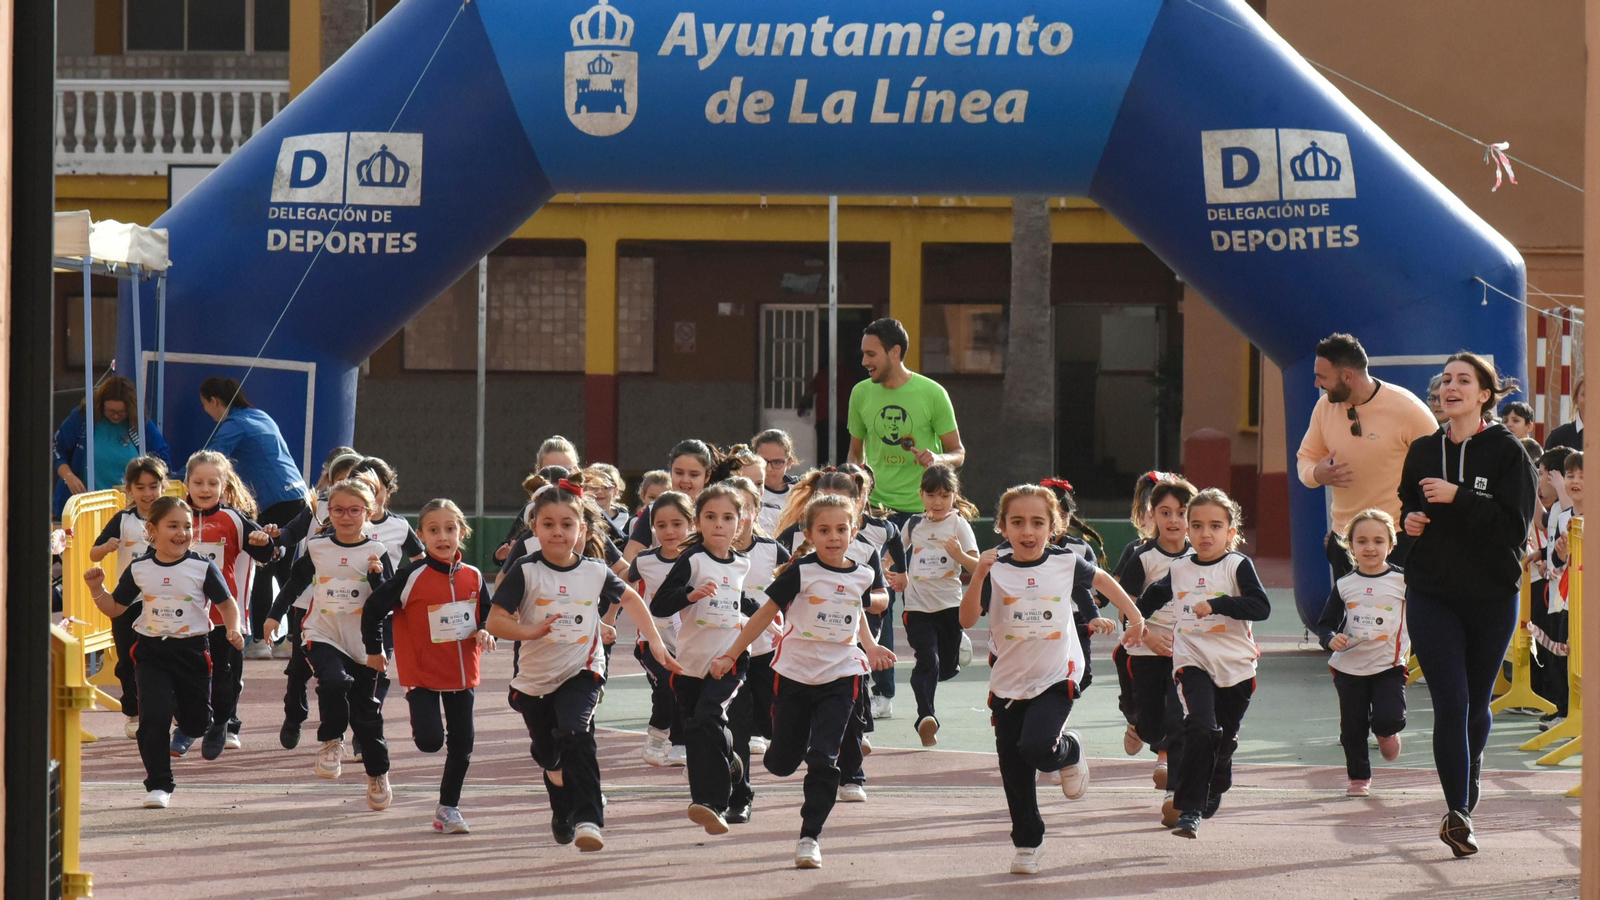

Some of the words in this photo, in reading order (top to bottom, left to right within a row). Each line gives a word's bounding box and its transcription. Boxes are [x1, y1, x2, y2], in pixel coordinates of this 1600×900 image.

[658, 10, 1074, 71] Ayuntamiento
[705, 76, 775, 124] de
[788, 78, 857, 124] La
[870, 76, 1029, 124] Línea
[289, 149, 328, 189] D
[1221, 147, 1261, 189] D
[268, 206, 367, 222] DELEGACIÓN
[371, 210, 392, 222] DE
[1207, 203, 1305, 221] DELEGACIÓN
[1309, 203, 1330, 216] DE
[267, 229, 418, 254] DEPORTES
[1211, 225, 1360, 252] DEPORTES
